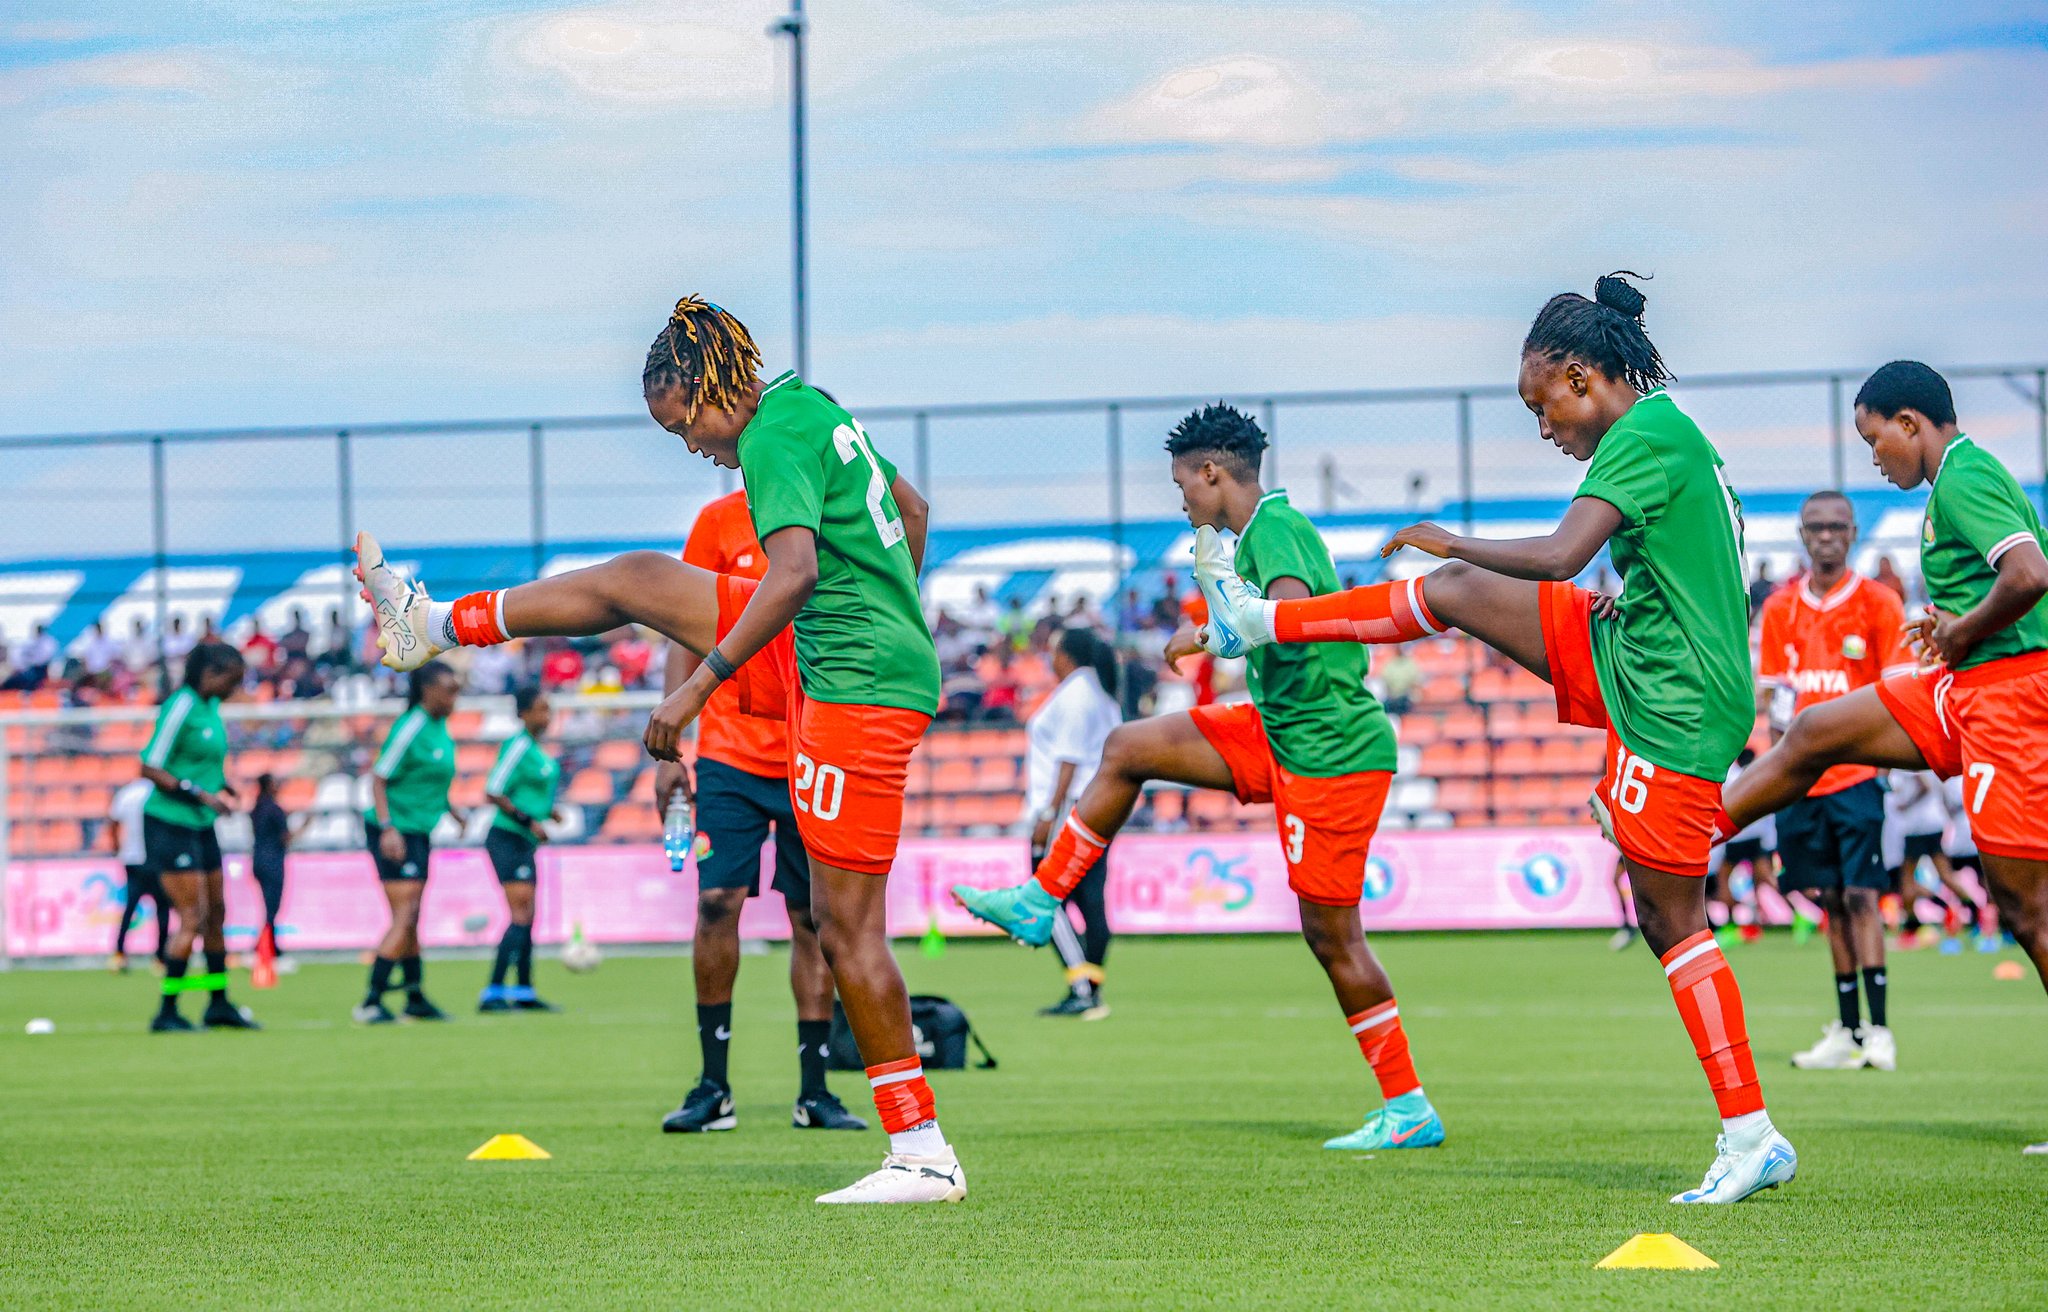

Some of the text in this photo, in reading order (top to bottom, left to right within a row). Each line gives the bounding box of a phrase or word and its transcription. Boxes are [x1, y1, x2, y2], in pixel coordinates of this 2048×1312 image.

[794, 752, 846, 821] 20
[1610, 746, 1655, 814] 16
[1968, 761, 1996, 815] 7
[1285, 813, 1306, 864] 3
